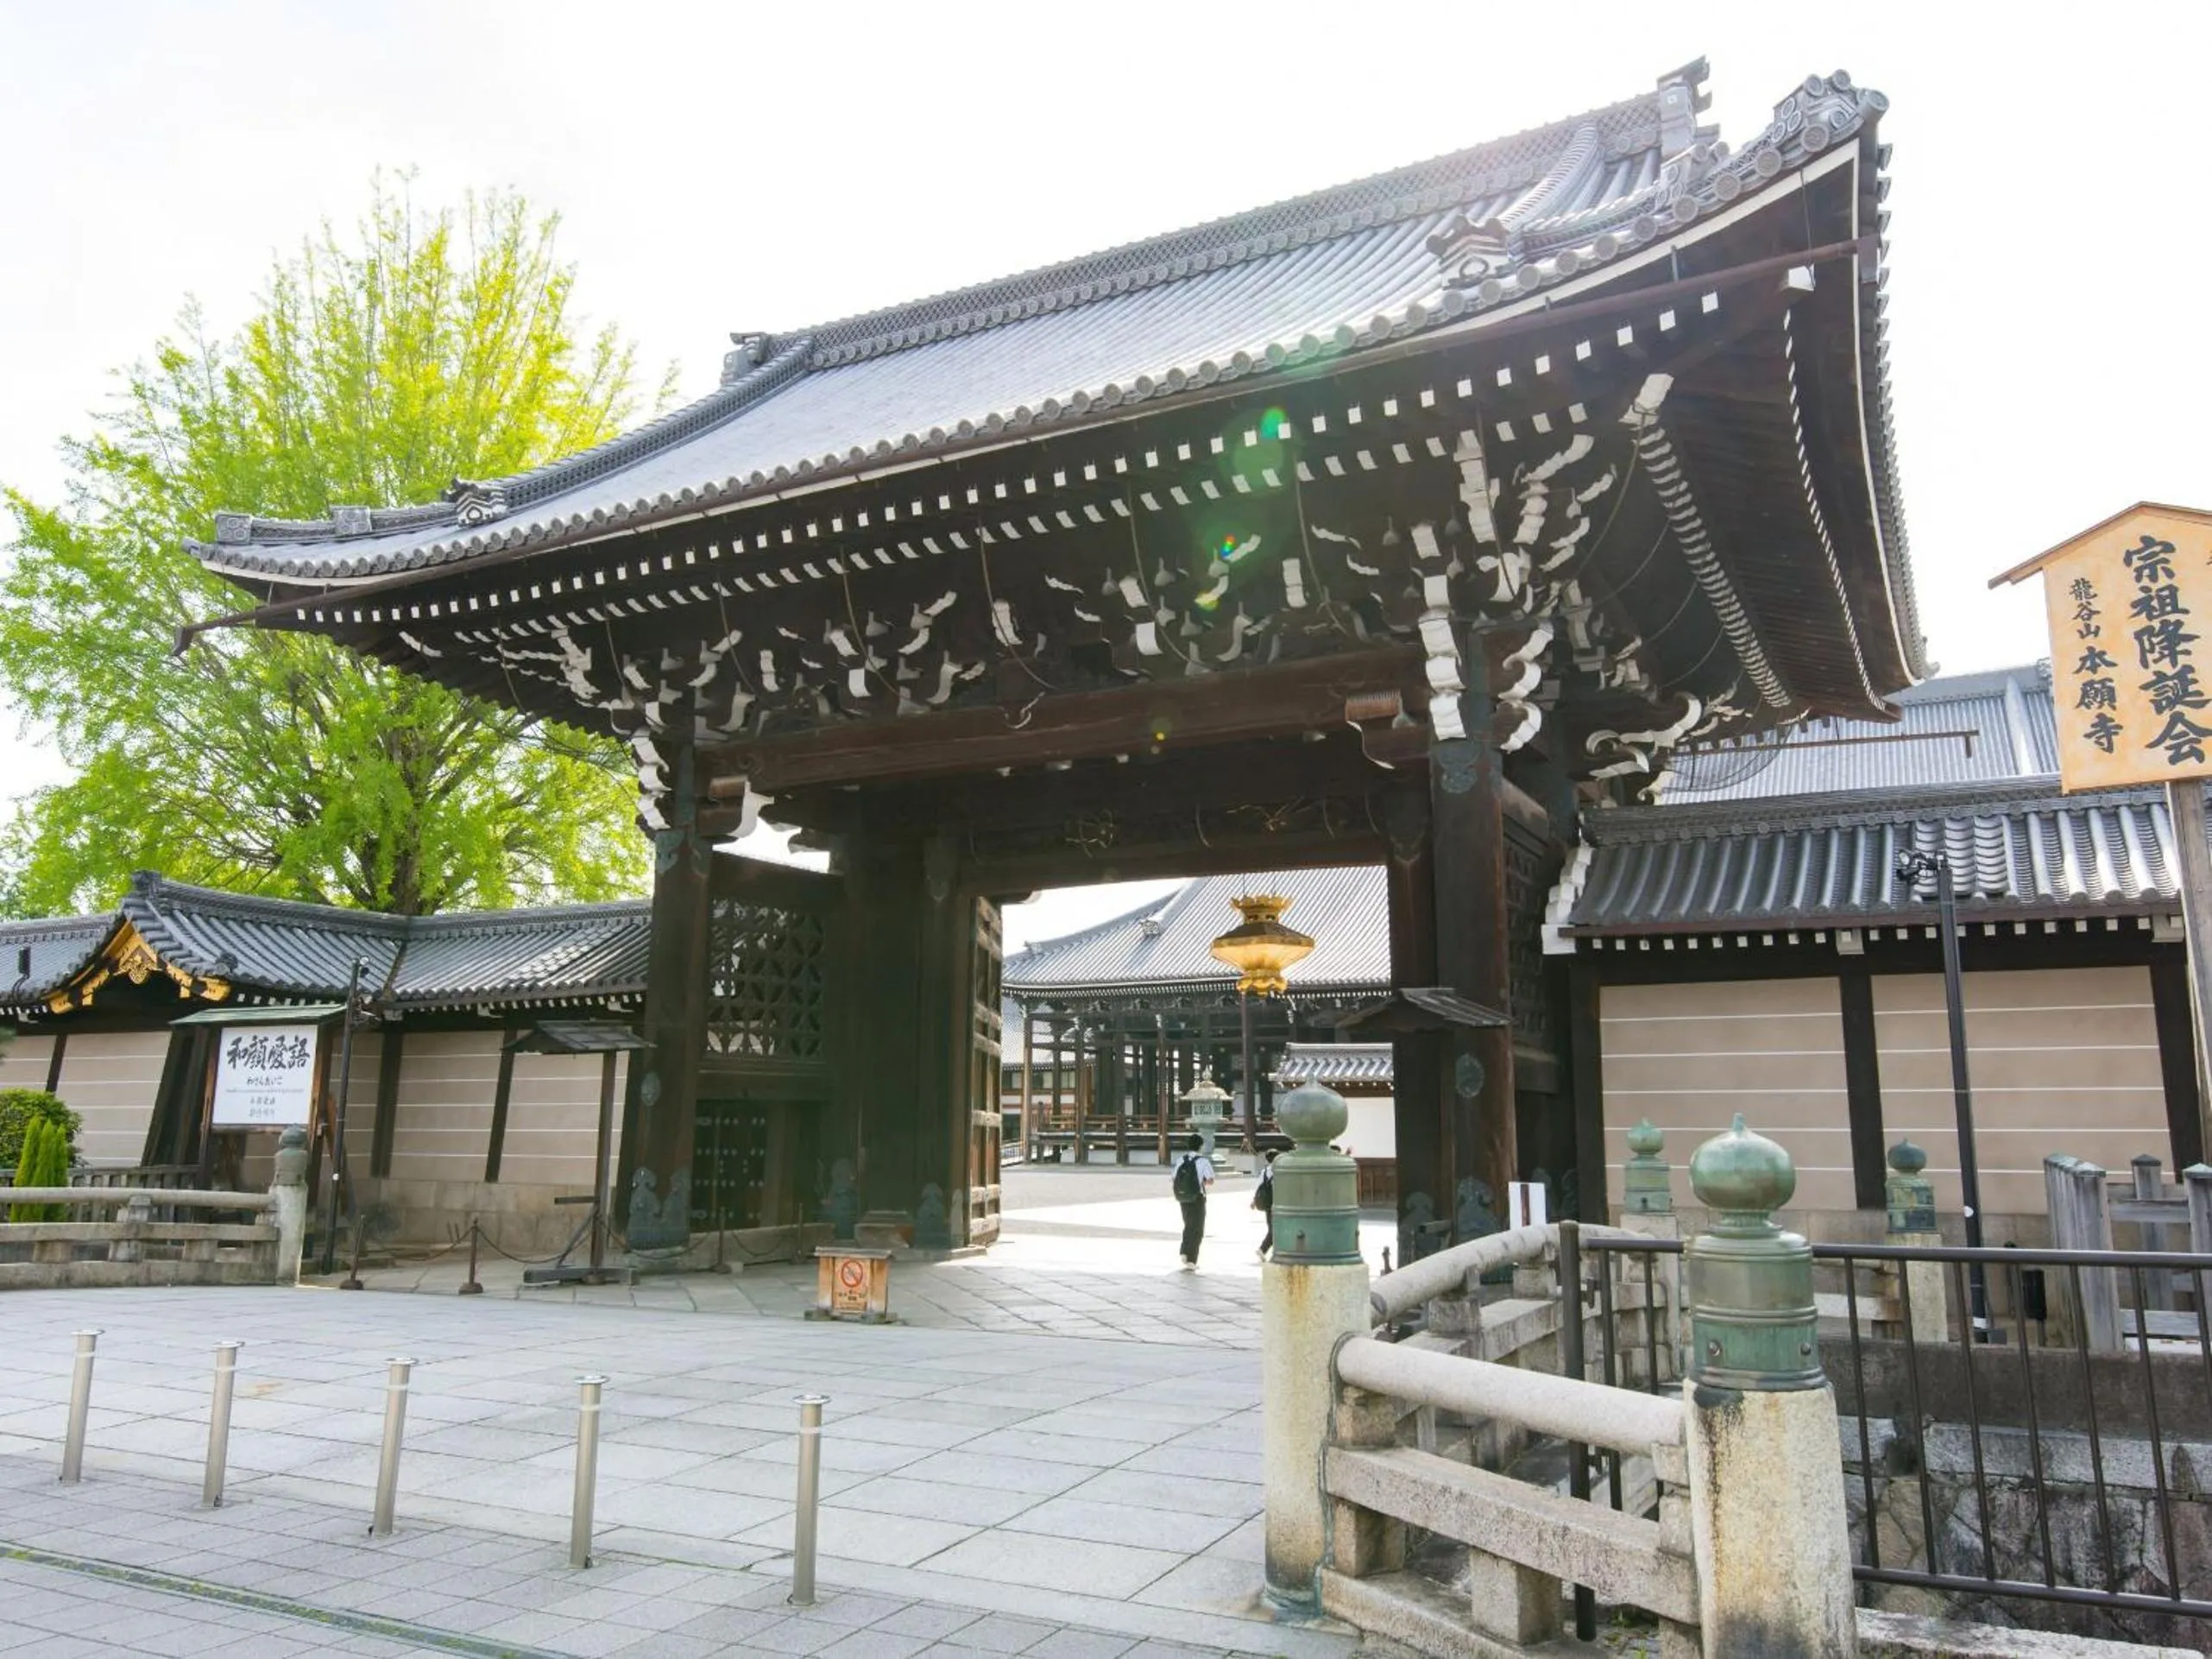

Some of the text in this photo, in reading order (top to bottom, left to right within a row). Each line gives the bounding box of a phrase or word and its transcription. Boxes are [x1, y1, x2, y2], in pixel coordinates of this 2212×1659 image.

[2124, 535, 2212, 766] 宗祖降誕会
